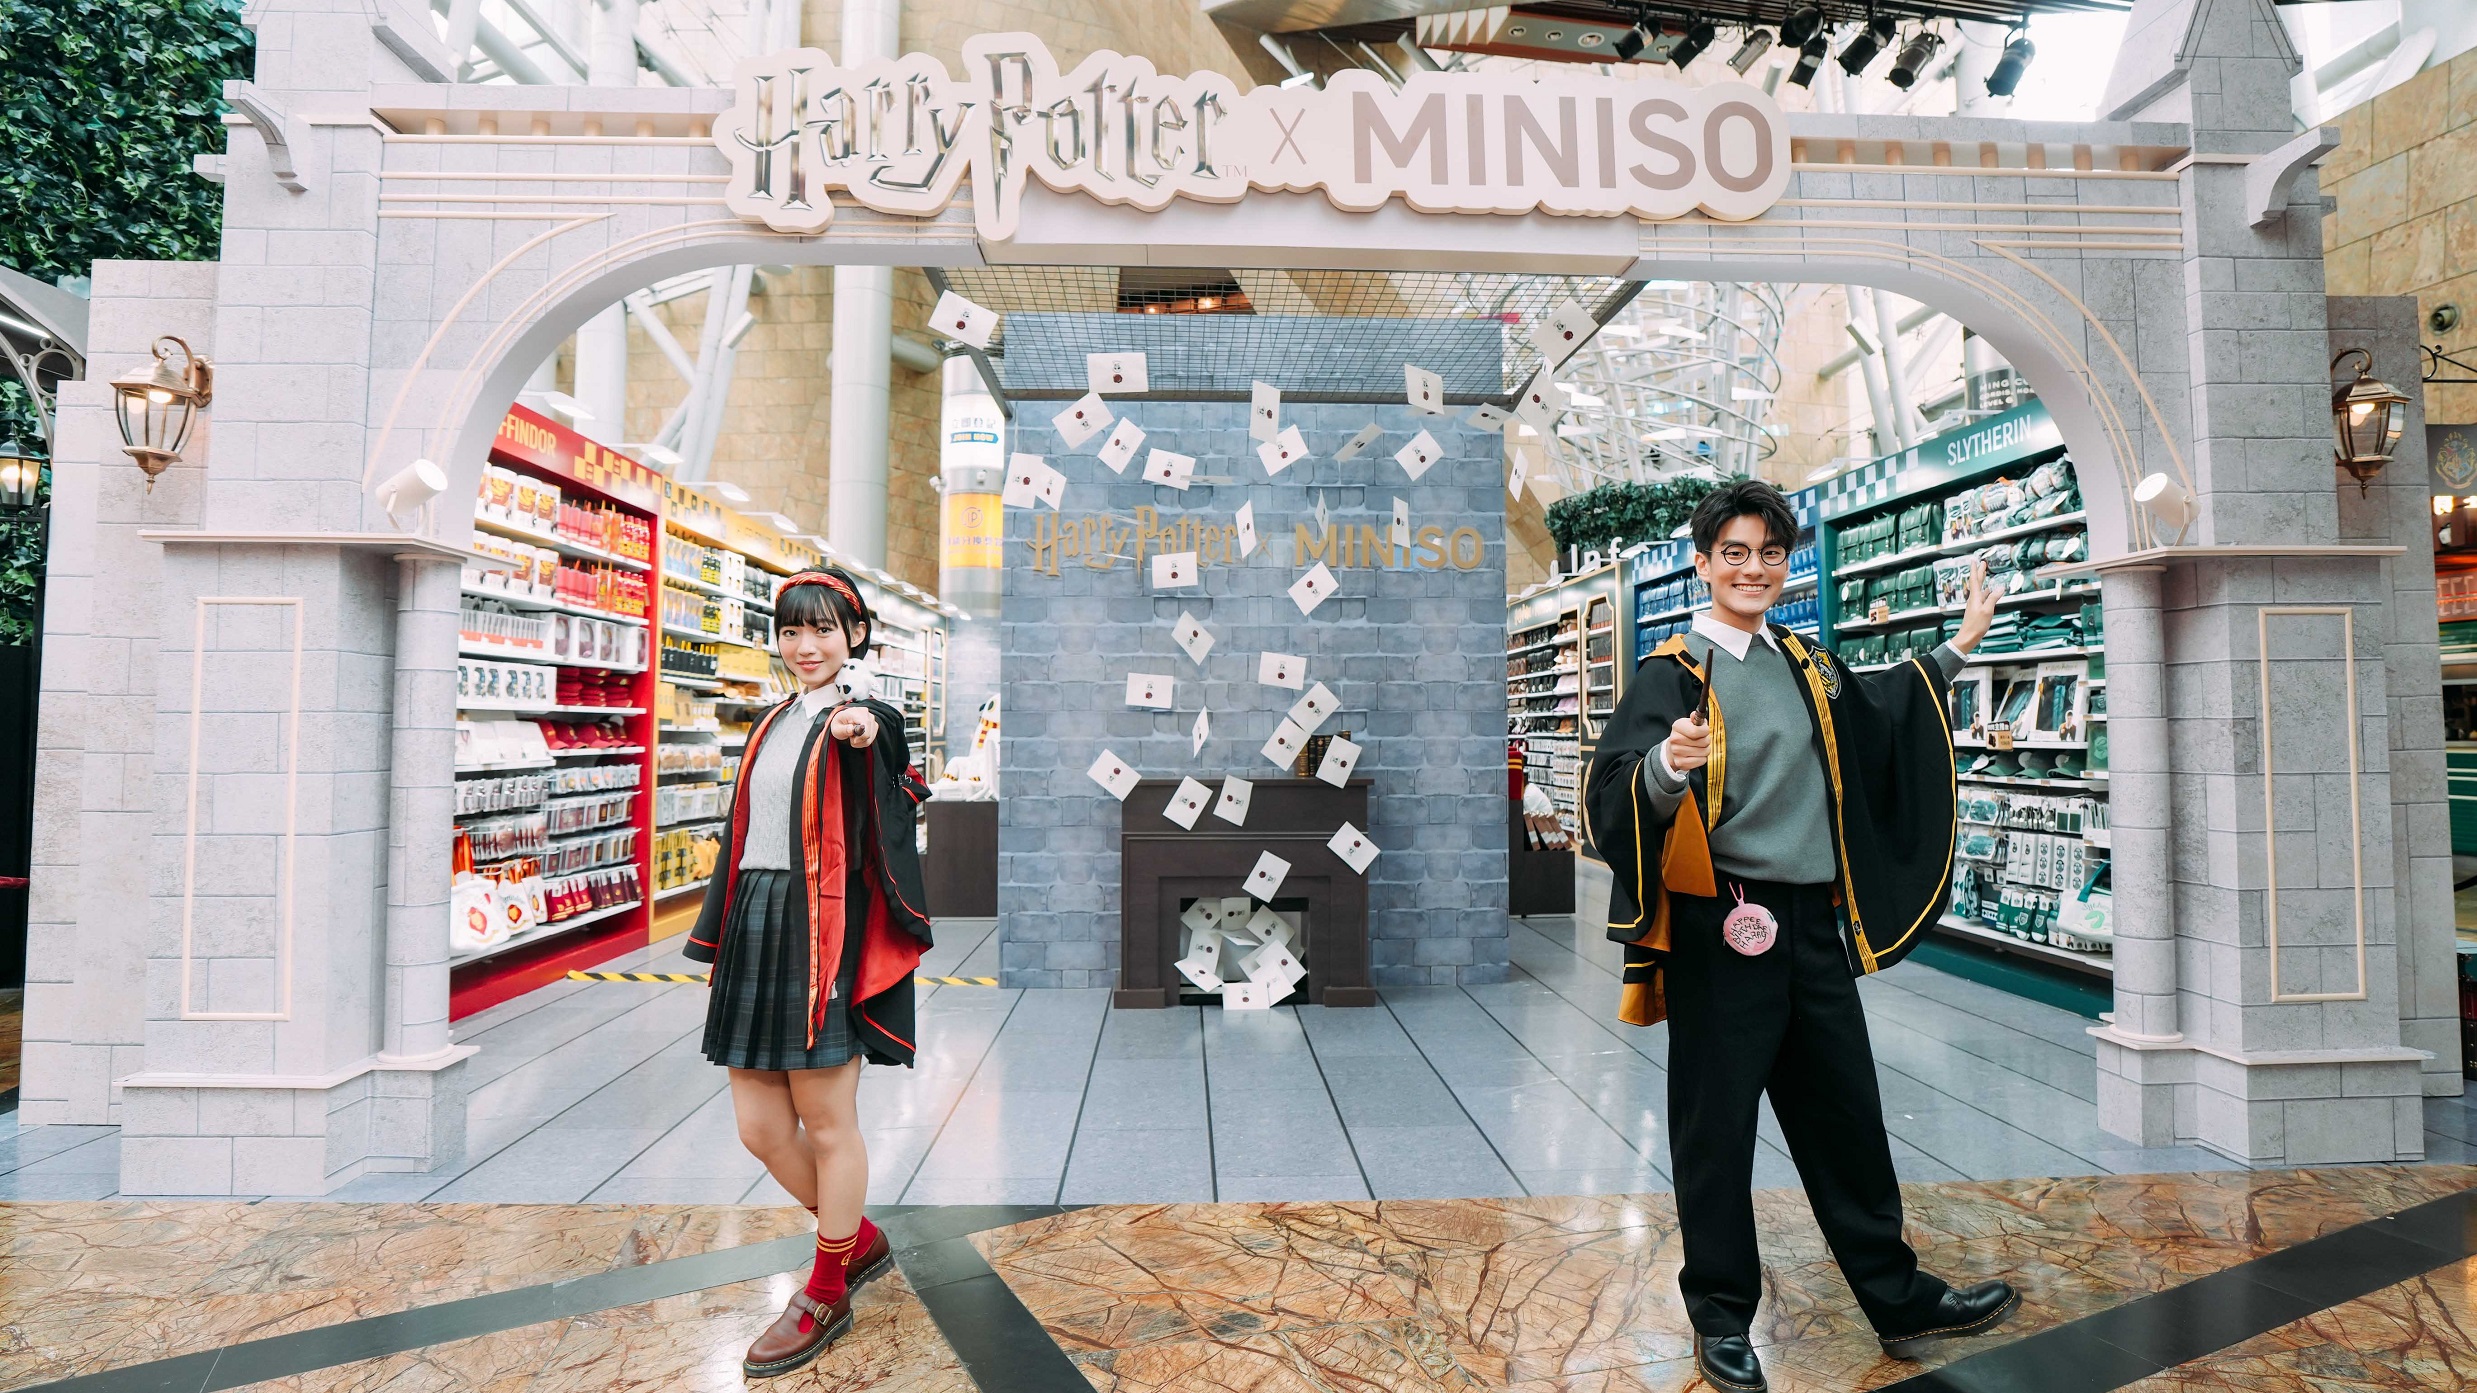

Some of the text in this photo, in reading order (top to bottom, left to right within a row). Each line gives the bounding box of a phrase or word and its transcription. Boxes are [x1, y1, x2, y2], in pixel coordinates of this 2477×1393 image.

[734, 68, 975, 210] Harry
[983, 51, 1228, 222] Potter
[1351, 91, 1774, 193] MINISO
[1947, 414, 2032, 466] SLYTHERIN
[1026, 512, 1131, 577] Harry
[1295, 523, 1484, 570] MINISO
[1740, 930, 1767, 949] HARRY
